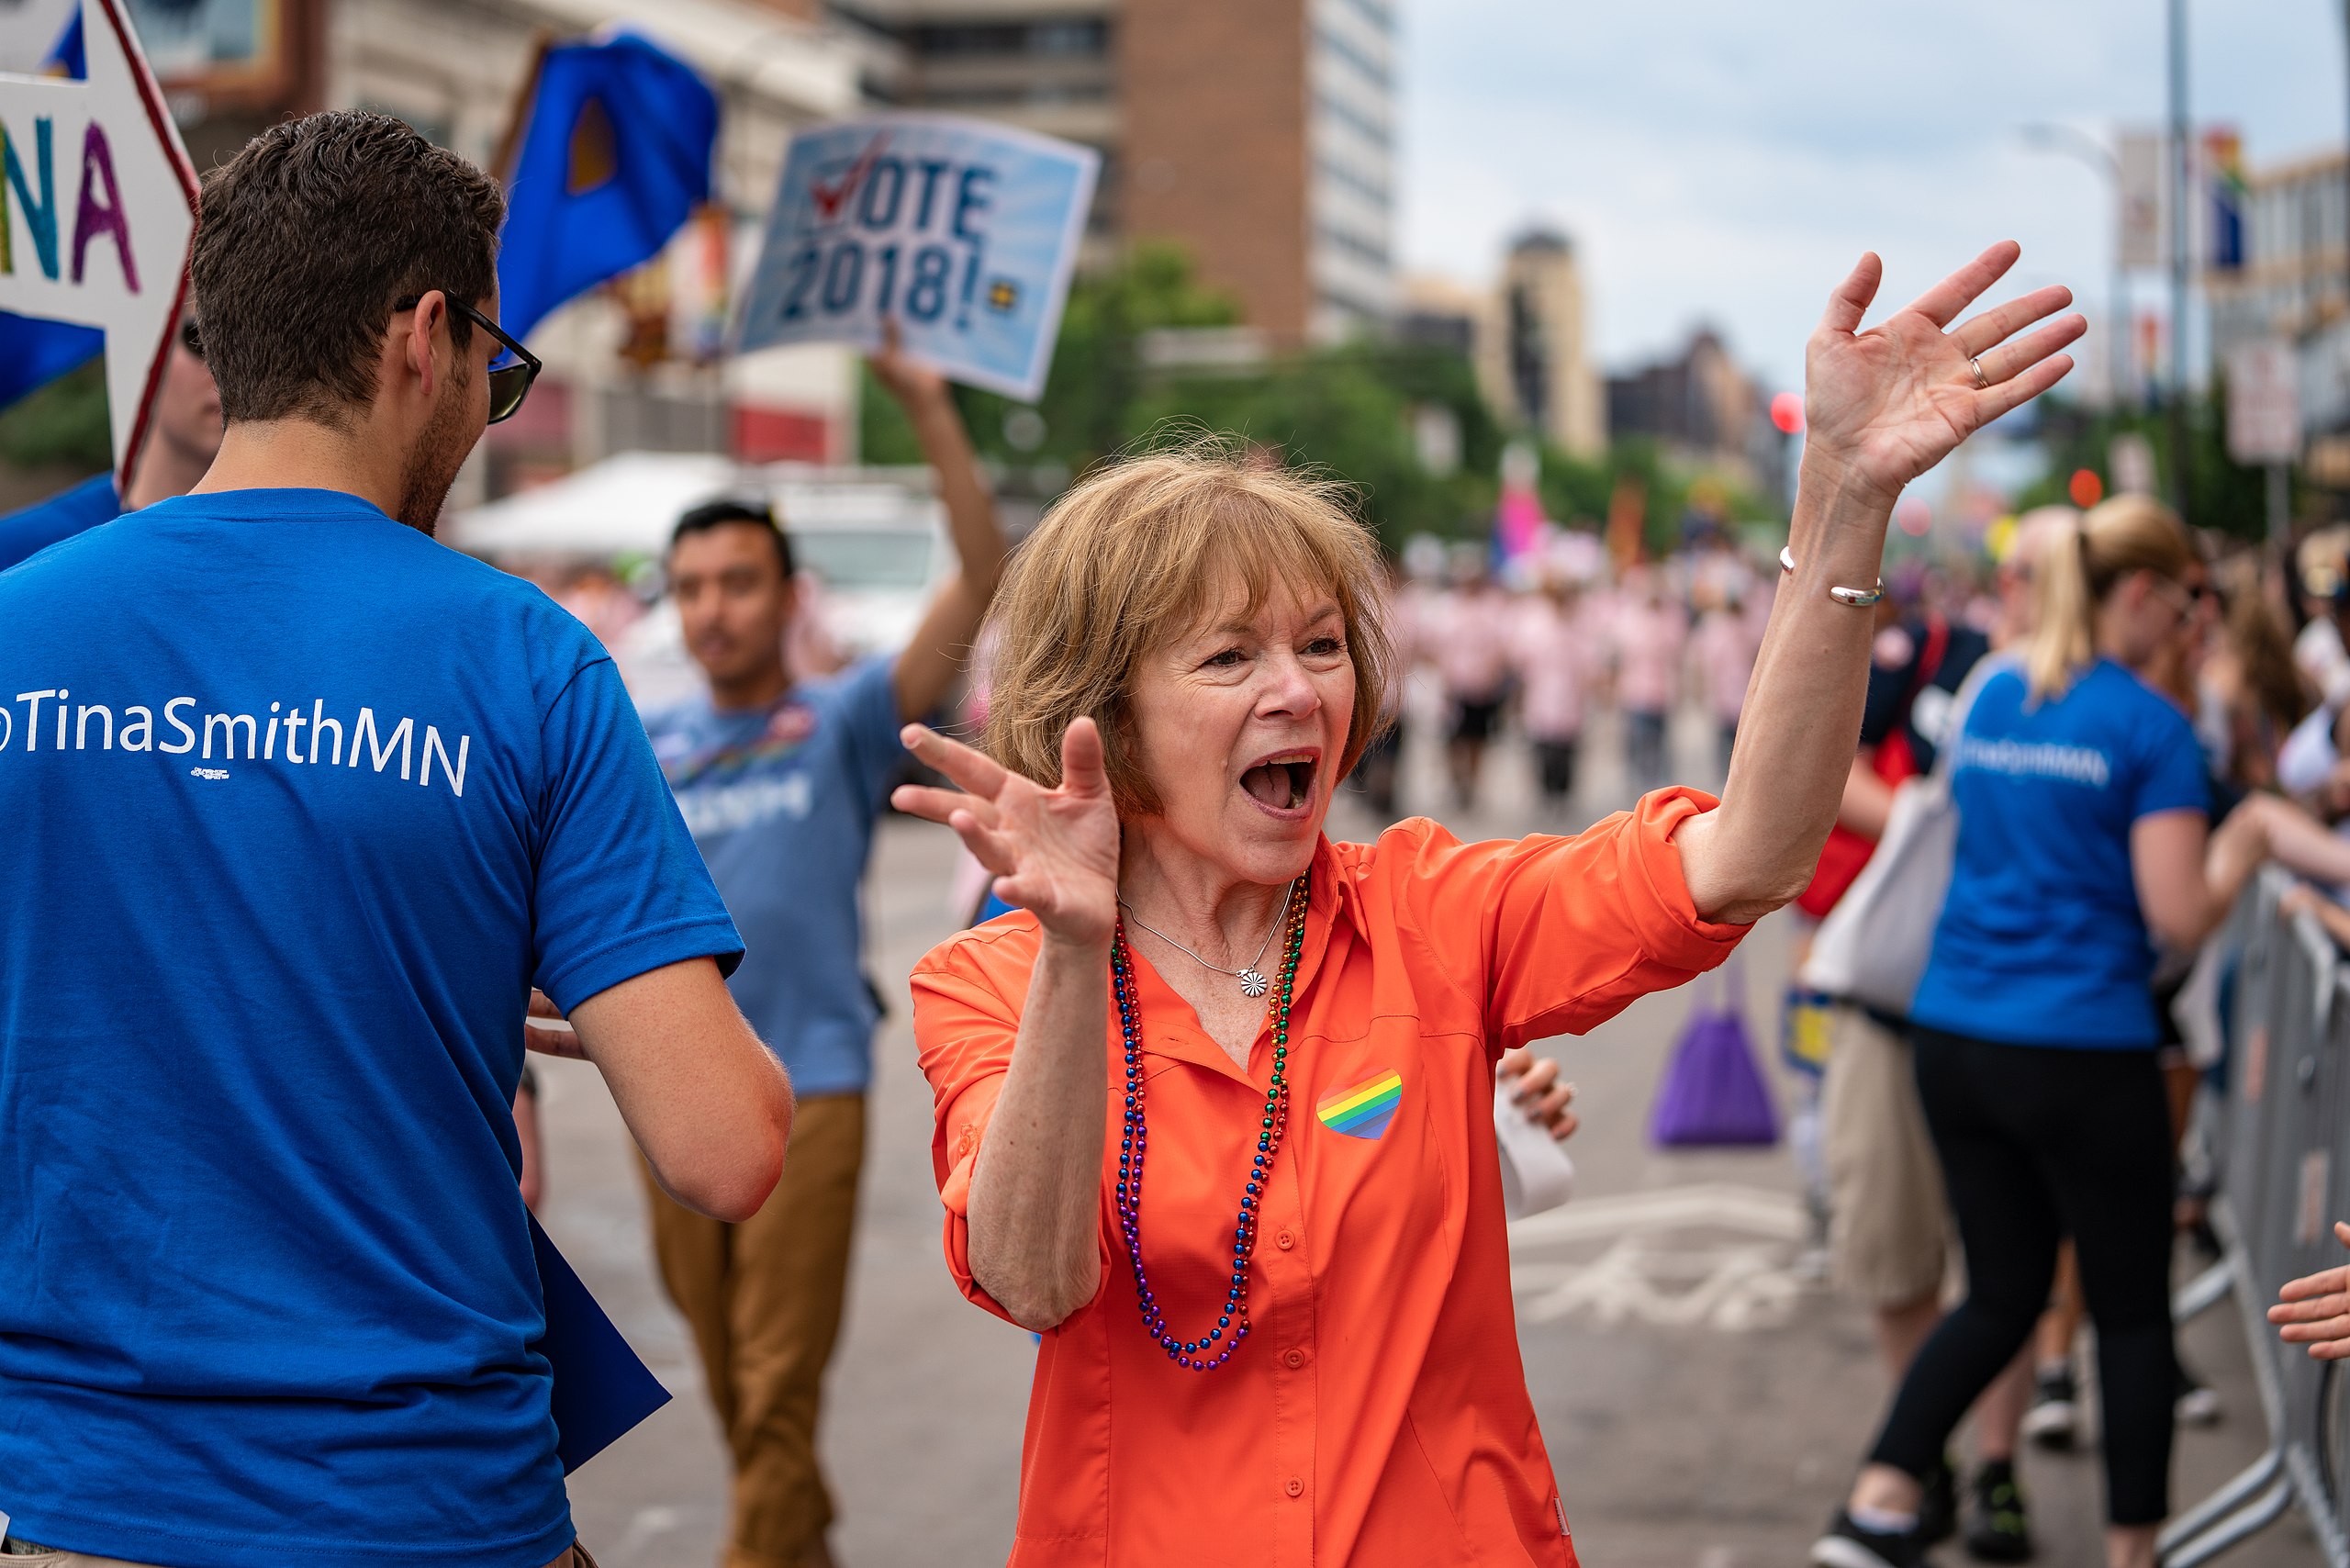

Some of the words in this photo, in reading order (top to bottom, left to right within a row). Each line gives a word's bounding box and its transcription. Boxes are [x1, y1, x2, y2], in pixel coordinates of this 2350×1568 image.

[808, 130, 998, 241] VOTE
[781, 233, 984, 332] 2018!
[0, 689, 470, 798] TinaSmithMN
